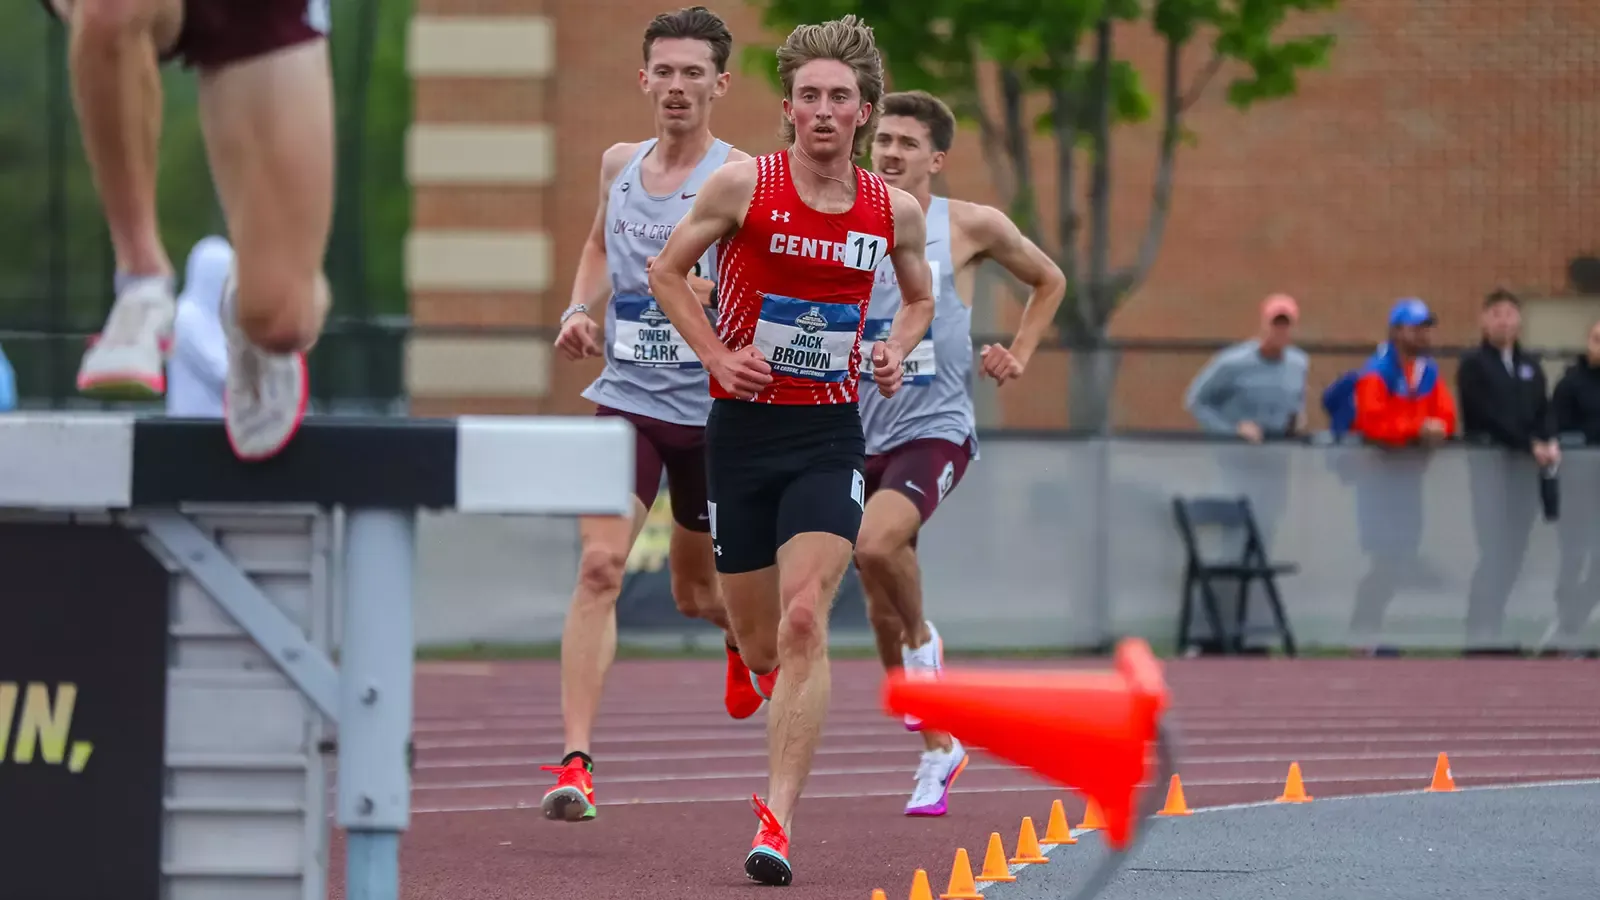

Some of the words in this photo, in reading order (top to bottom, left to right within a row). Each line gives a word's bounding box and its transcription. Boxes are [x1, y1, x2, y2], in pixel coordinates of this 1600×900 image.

[649, 224, 675, 240] CRO
[770, 233, 846, 262] CENTR
[853, 237, 878, 270] 11
[638, 329, 671, 342] OWEN
[791, 333, 824, 350] JACK
[634, 344, 679, 361] CLARK
[773, 347, 831, 369] BROWN
